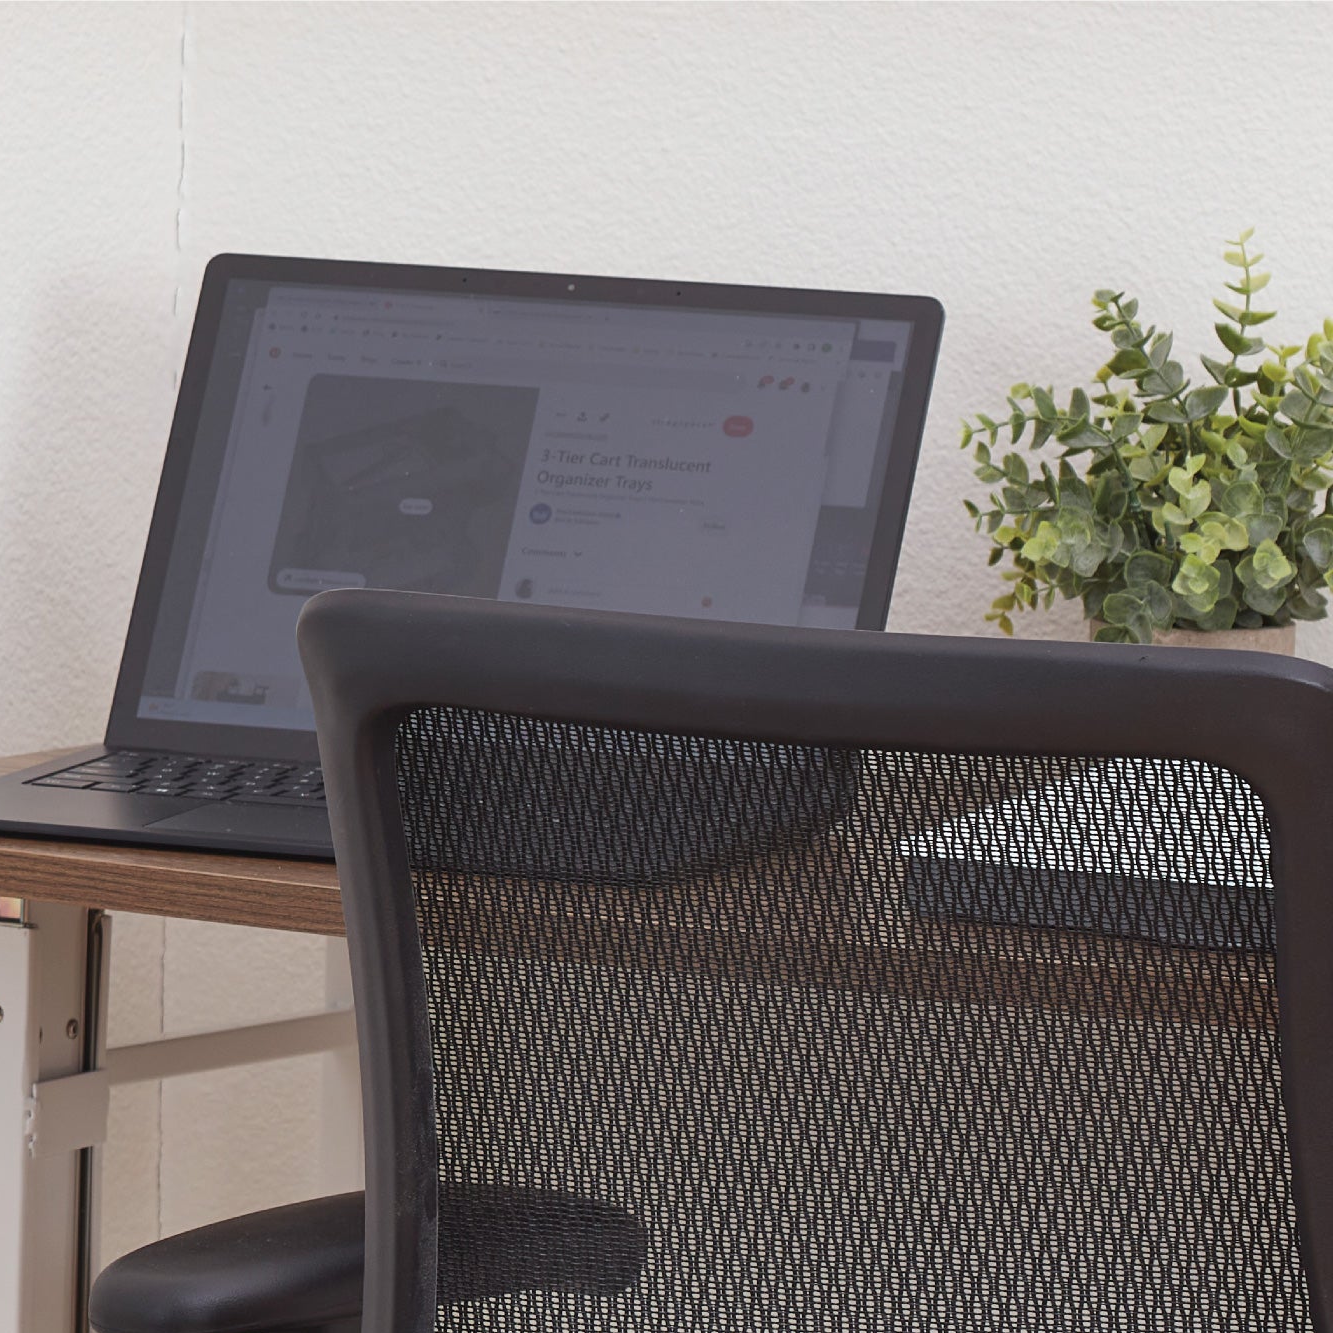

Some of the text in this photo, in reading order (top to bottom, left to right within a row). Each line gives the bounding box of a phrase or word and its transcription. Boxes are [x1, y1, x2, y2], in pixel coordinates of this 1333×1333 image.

[540, 449, 712, 474] 3-Tier Cart Translucent
[536, 470, 654, 493] Organizer Trays
